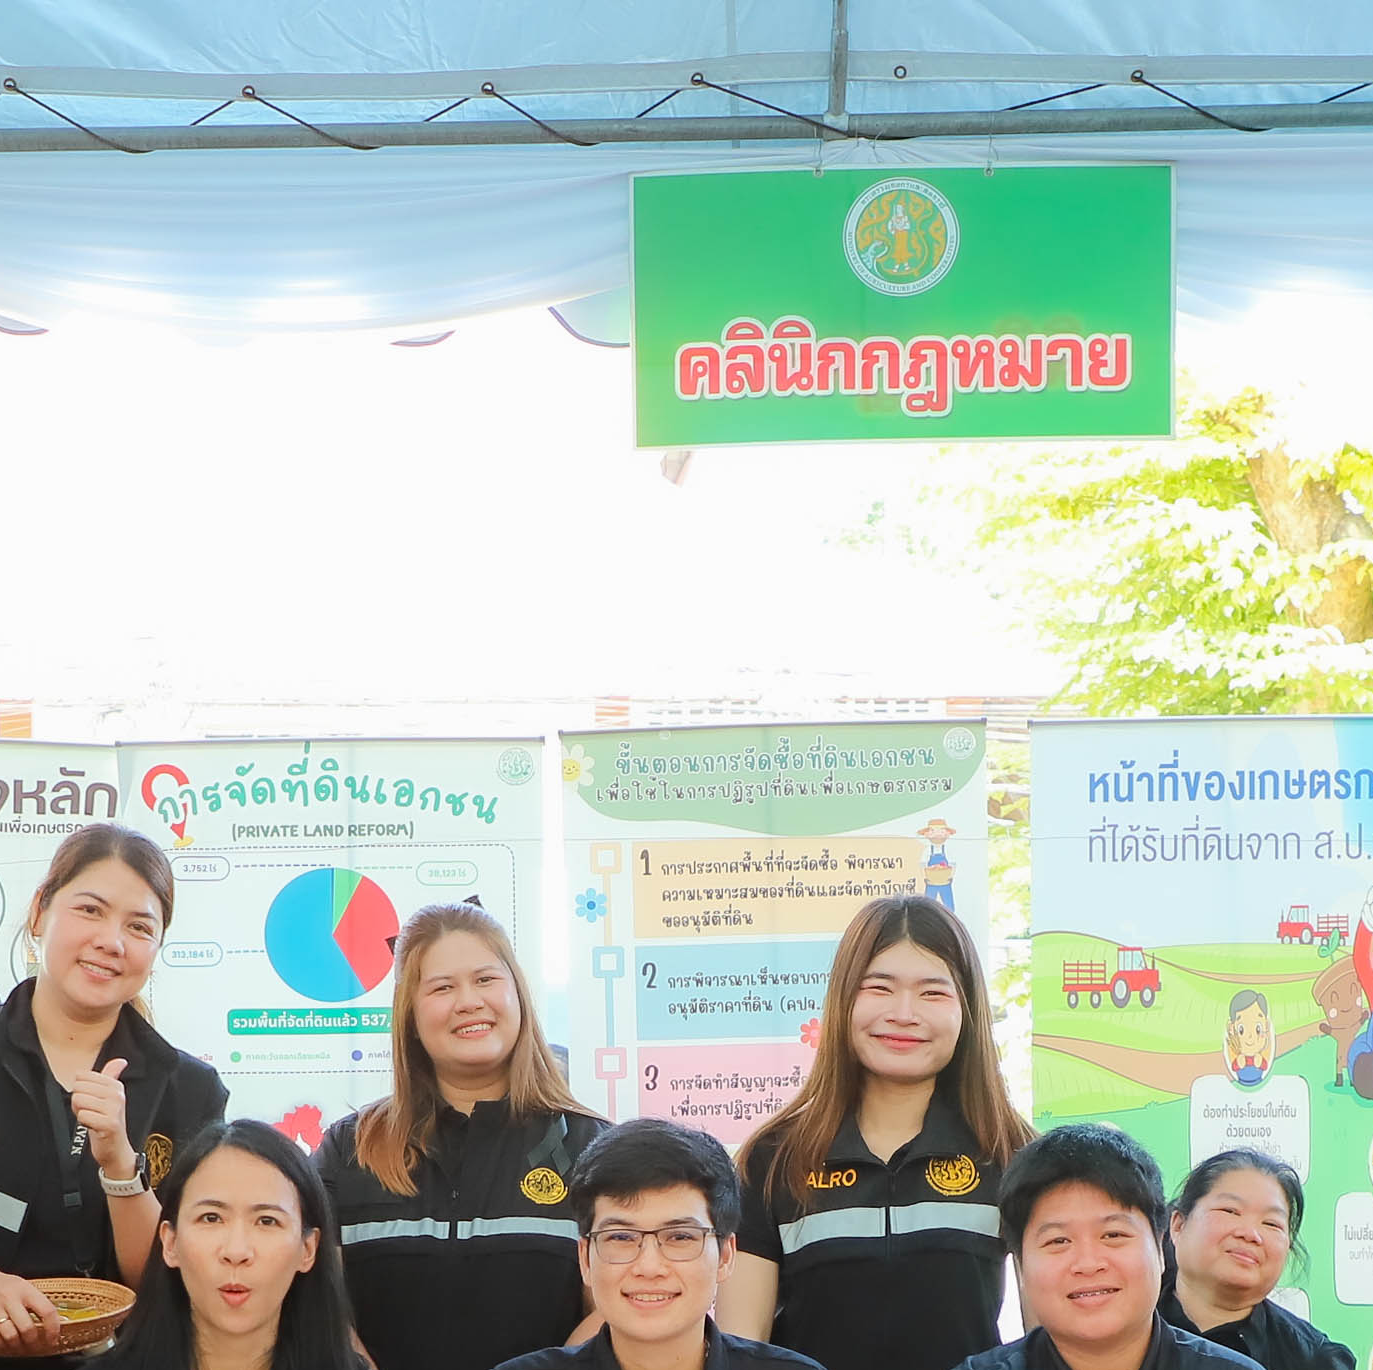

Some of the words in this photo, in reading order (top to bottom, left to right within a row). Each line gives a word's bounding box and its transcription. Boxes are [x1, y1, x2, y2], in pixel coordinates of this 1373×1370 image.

[677, 318, 1131, 415] คลินิกกฎหมาย
[614, 737, 935, 775] ขั้นตอนการจัดซื้อที่ดินเอกชน
[157, 741, 499, 824] การจัดที่ดินเอกชน
[596, 775, 953, 805] เพื่อใช้ในการปฏิรูปที่ดินเพื่อเกษตรกรรม
[232, 823, 299, 839] (PRIVATE
[303, 824, 344, 838] LAND
[348, 822, 414, 838] REFORM)
[1088, 814, 1302, 862] ที่ได้รับที่ดินจาก
[639, 850, 652, 876] 1
[661, 849, 838, 875] การประกาศพื้นที่ที่จะจัดซื้อ
[845, 853, 903, 871] พิจารณา
[662, 905, 754, 931] ขออนุมัติที่ดิน
[642, 962, 657, 990] 2
[233, 1012, 358, 1029] รวมพื้นที่จัดที่ดินแล้ว
[361, 1014, 391, 1029] 537,
[668, 992, 773, 1022] อนุมัติราคาที่ดิน
[645, 1064, 658, 1091] 3
[670, 1092, 788, 1121] เพื่อการปฏิรูปที่ดิ
[1203, 1100, 1297, 1118] ต้องทำประโยชน์ในที่ดิน
[1226, 1123, 1272, 1138] ด้วยตนเอง
[805, 1168, 857, 1190] ALRO
